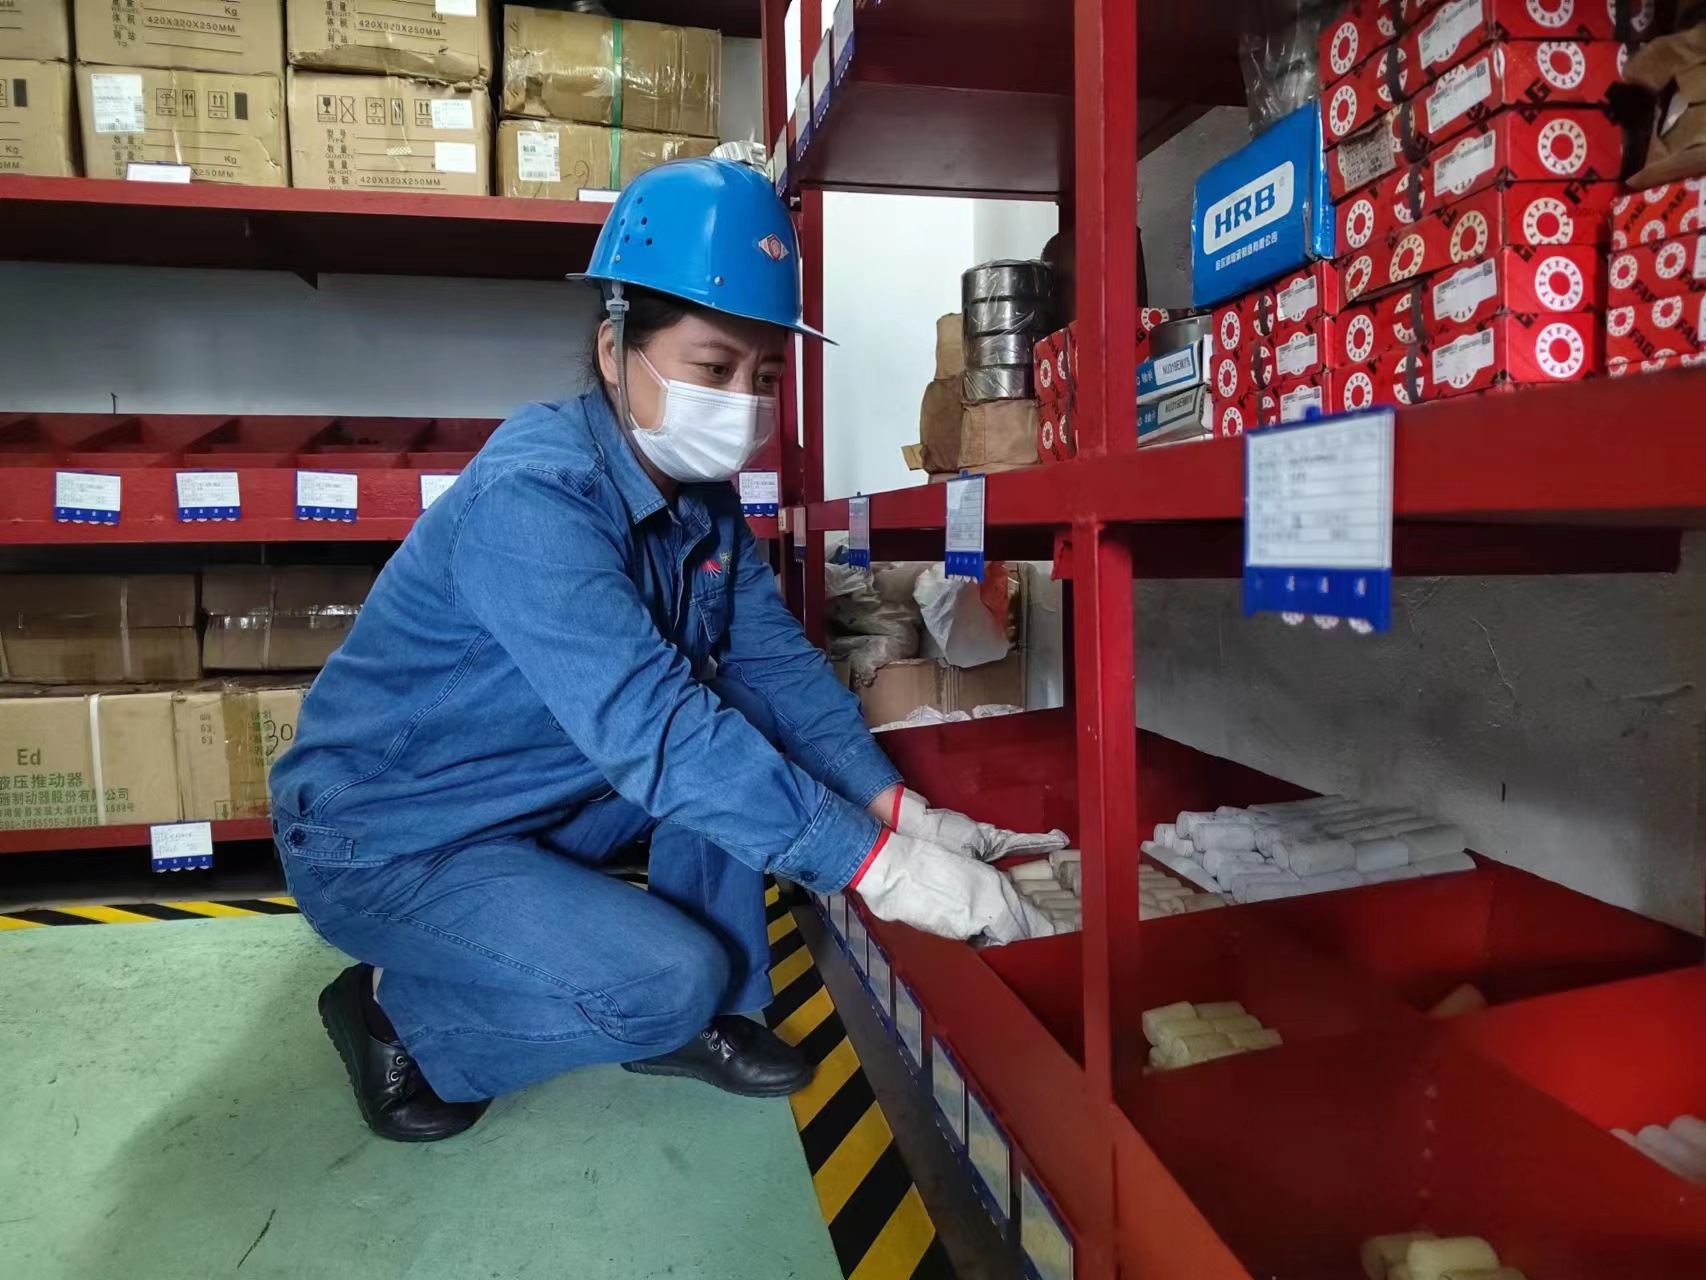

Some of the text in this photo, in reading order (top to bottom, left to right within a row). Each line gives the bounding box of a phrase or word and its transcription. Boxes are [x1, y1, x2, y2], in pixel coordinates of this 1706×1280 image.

[224, 6, 238, 16] Kg
[148, 16, 236, 33] 420X320X250MM
[5, 145, 19, 155] Kg
[224, 155, 237, 165] Kg
[360, 175, 442, 186] 420X320X250MM
[1214, 183, 1276, 240] HRB
[16, 748, 41, 766] Ed
